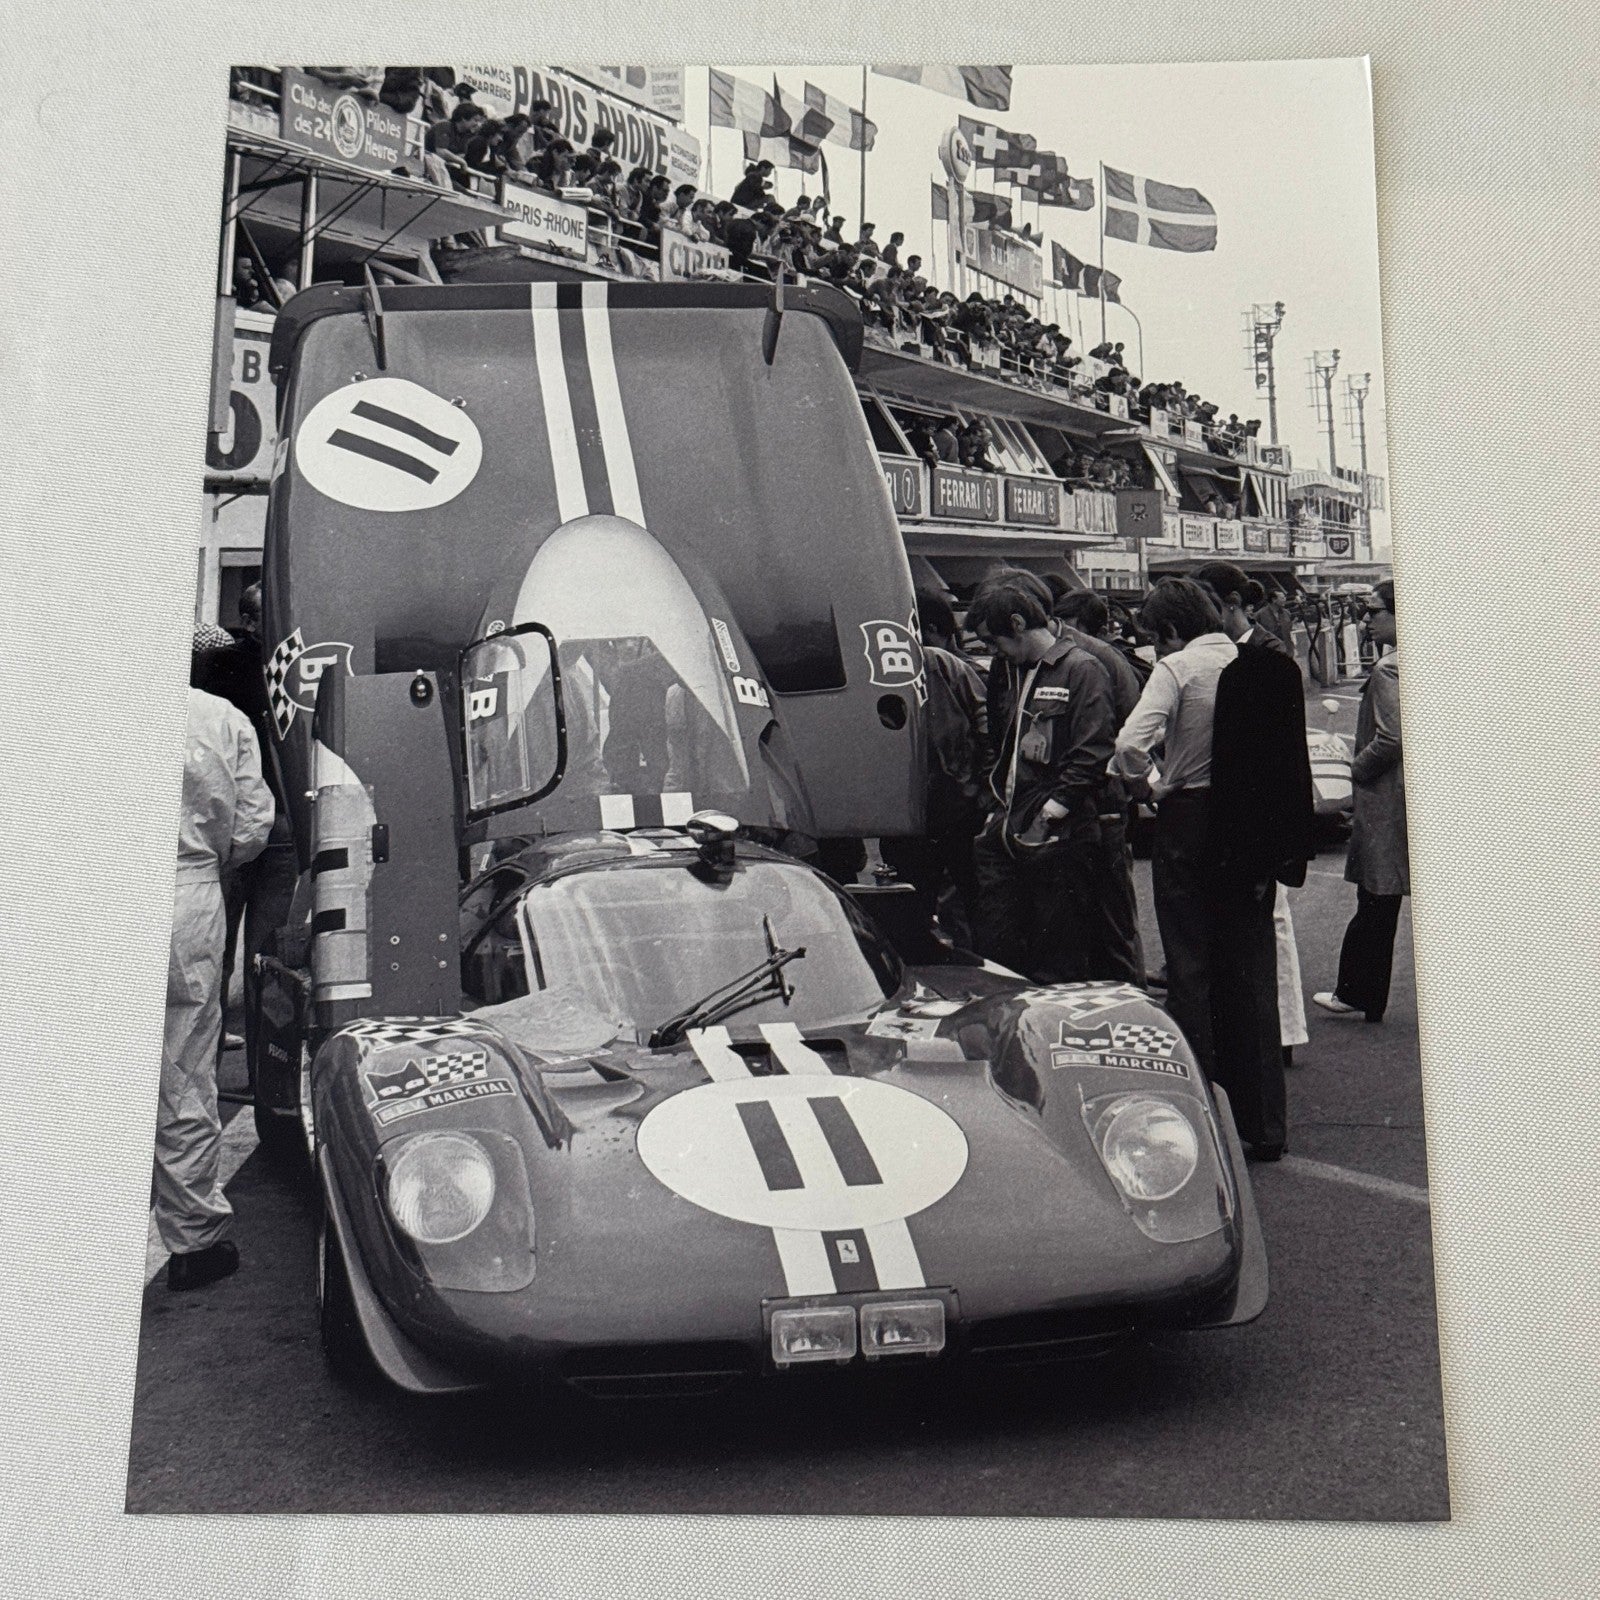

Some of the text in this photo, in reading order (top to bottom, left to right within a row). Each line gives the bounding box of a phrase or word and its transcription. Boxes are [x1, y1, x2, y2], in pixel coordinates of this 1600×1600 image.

[291, 83, 316, 110] Club
[317, 97, 332, 116] des
[294, 113, 399, 164] des 24 Heures
[326, 400, 460, 485] 11
[904, 475, 912, 500] 7
[940, 477, 981, 510] FERRARI
[1013, 486, 1046, 515] FERRARI
[1333, 540, 1348, 551] BP
[876, 627, 915, 675] BP
[1105, 1055, 1185, 1076] MARCHAL
[428, 1080, 510, 1106] MARCHAL
[735, 1096, 884, 1191] 11
